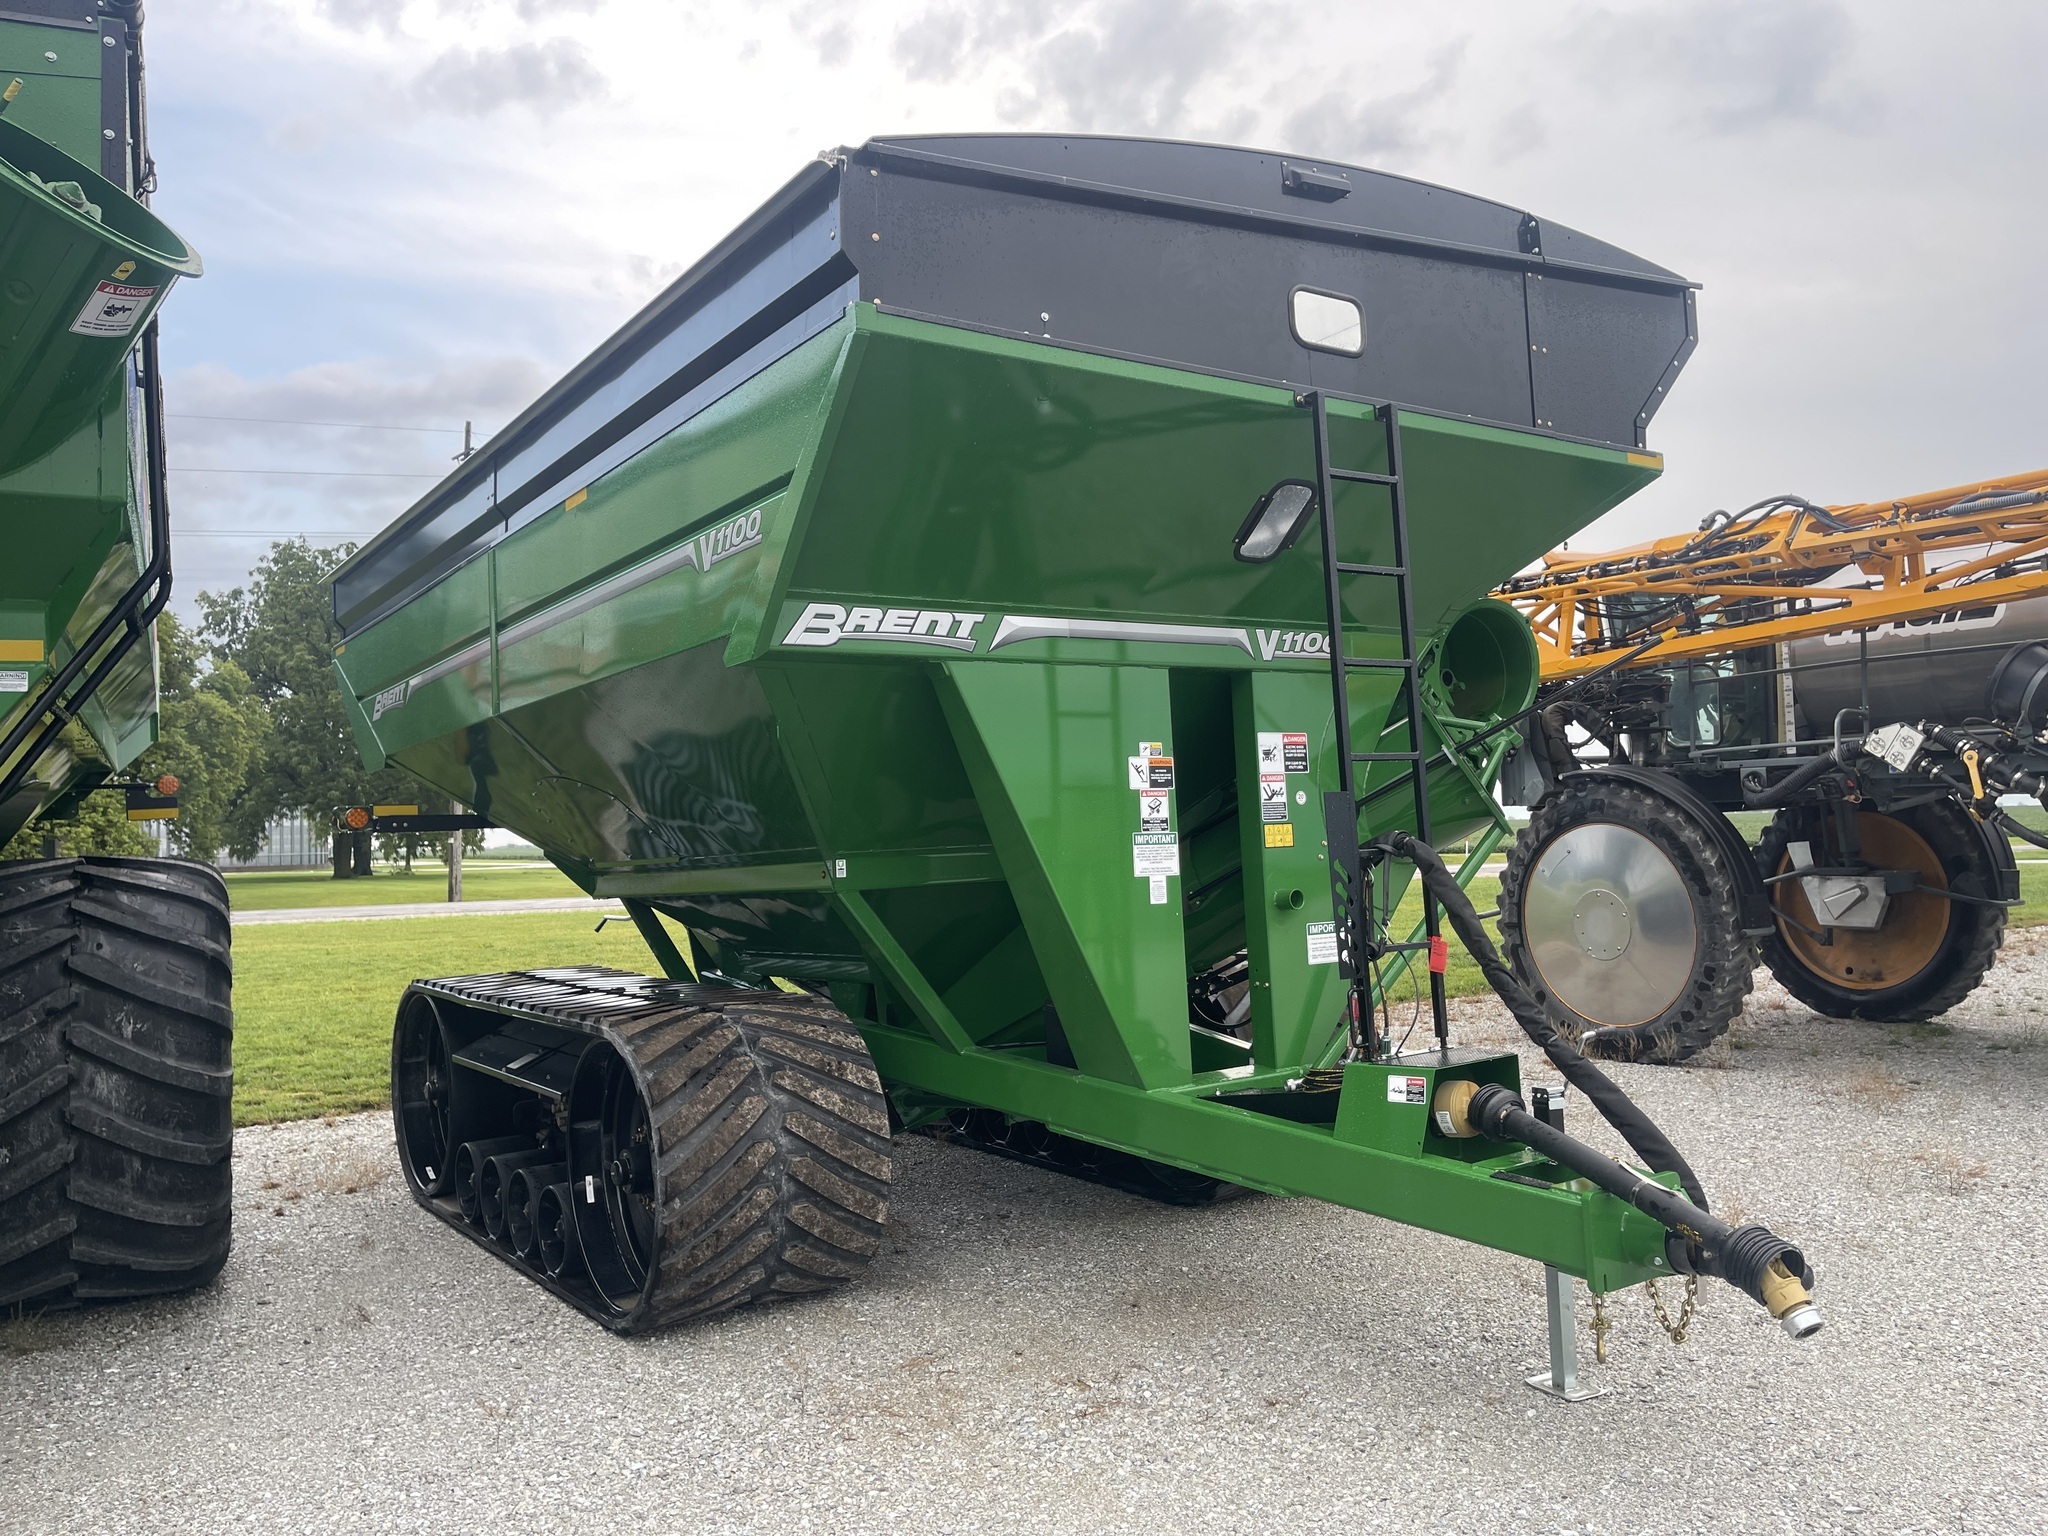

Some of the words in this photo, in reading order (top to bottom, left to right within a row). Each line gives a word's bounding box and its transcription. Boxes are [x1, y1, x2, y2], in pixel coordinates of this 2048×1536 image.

[116, 287, 154, 296] DANGER
[699, 509, 763, 573] V1100
[781, 602, 986, 653] BRENT
[372, 682, 406, 722] BRENT
[1135, 834, 1176, 845] IMPORTANT
[1309, 923, 1335, 935] IMPOR
